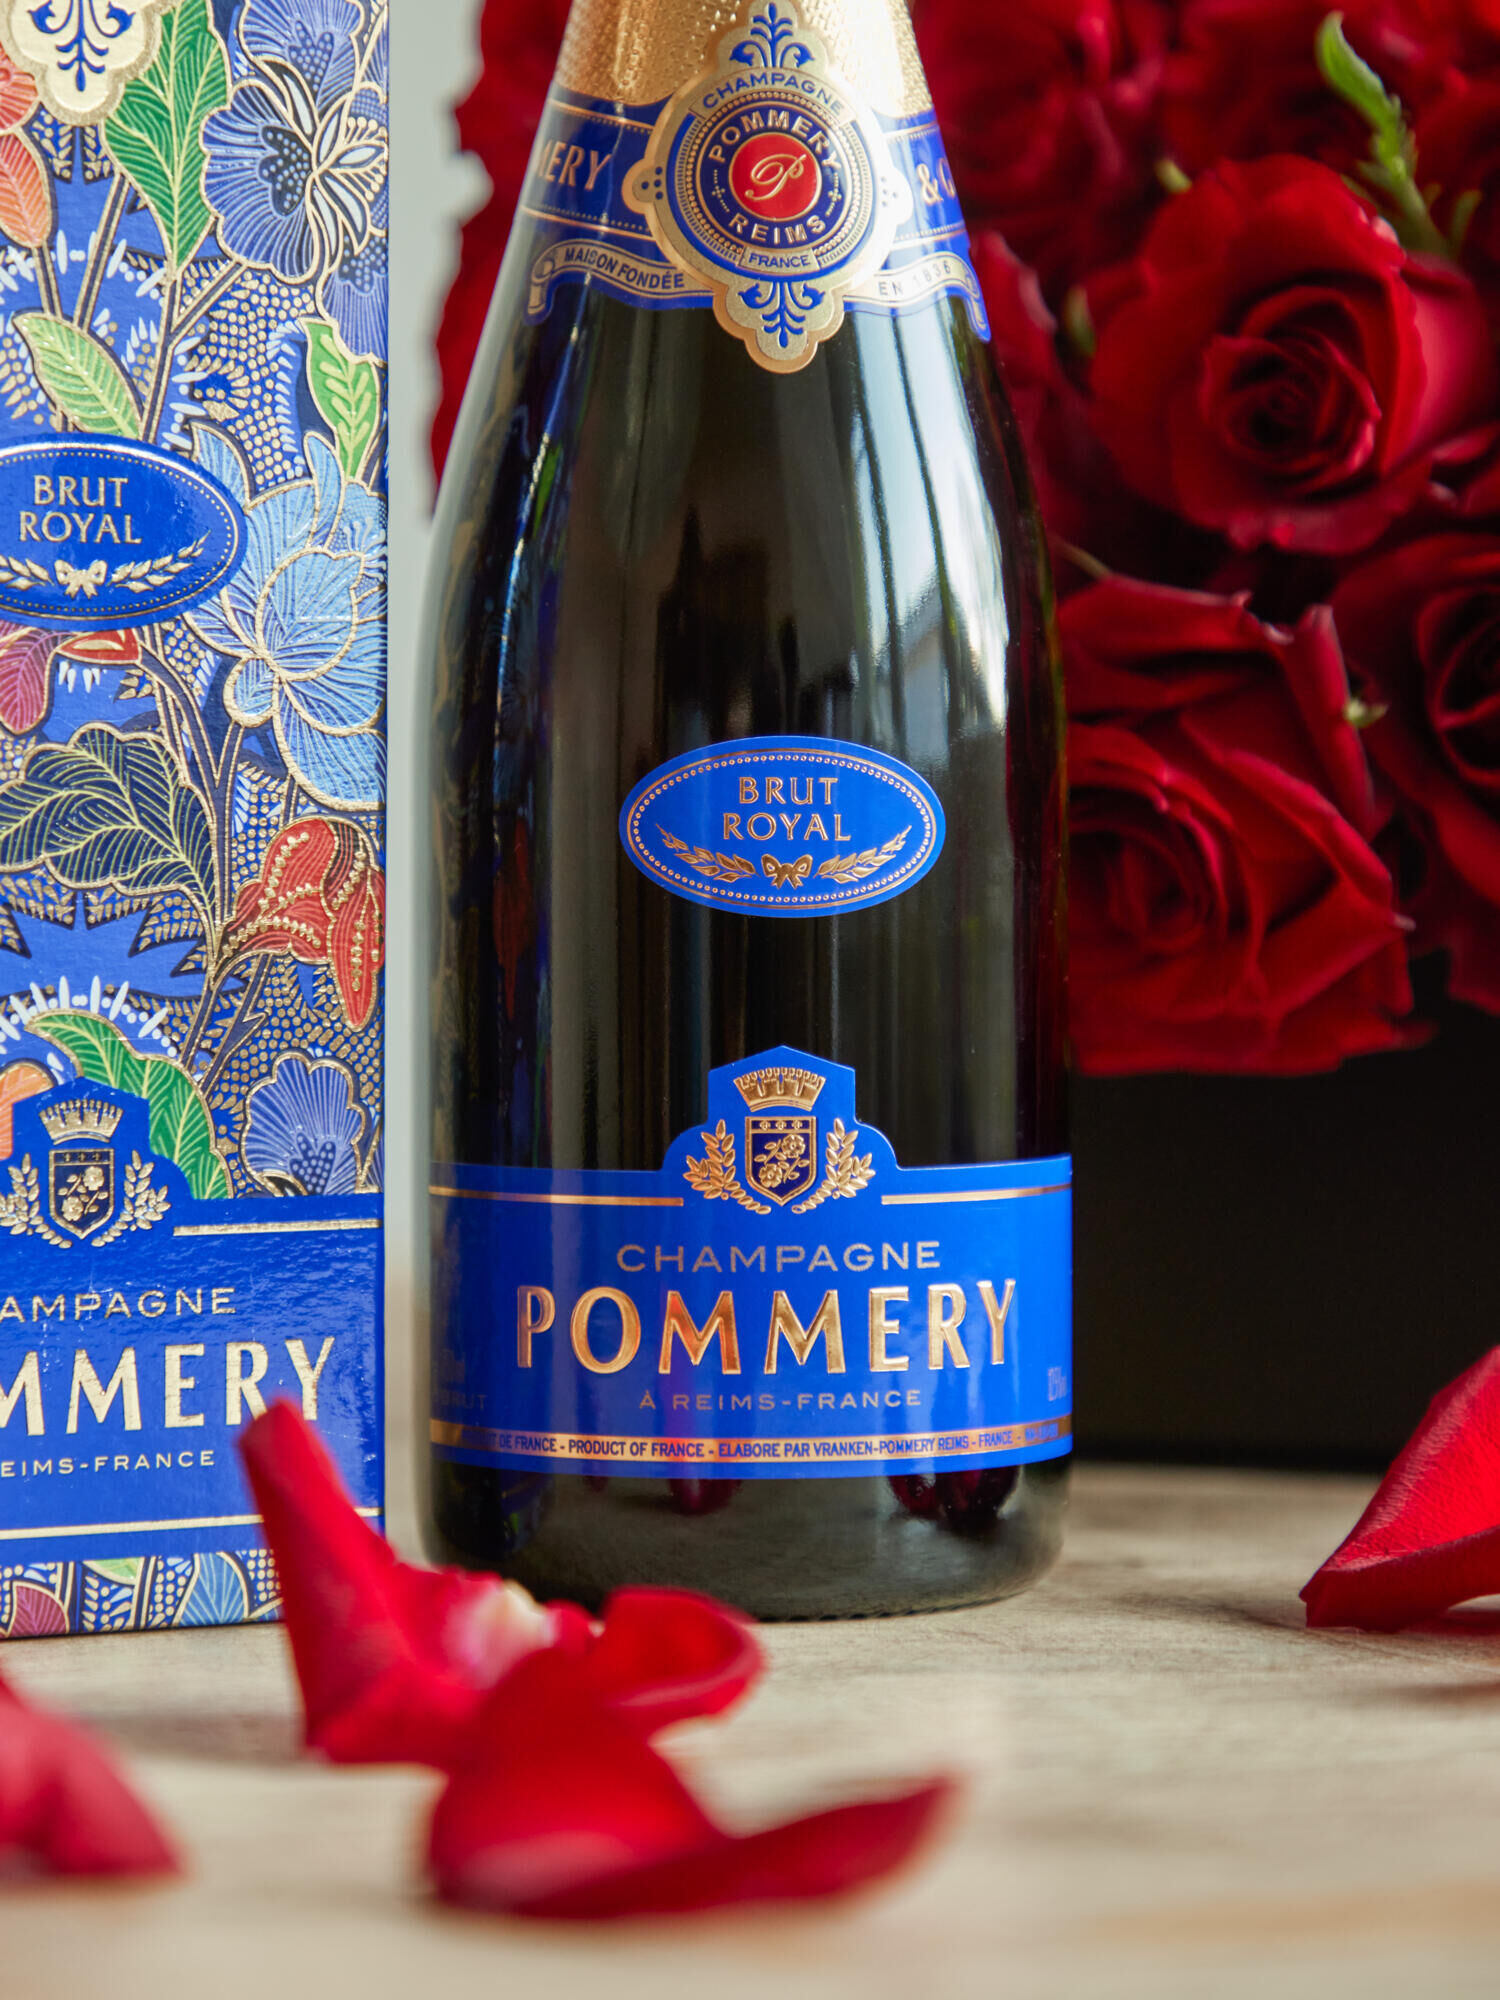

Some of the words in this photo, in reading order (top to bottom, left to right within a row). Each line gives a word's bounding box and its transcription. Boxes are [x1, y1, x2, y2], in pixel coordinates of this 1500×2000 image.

[702, 72, 845, 116] CHAMPAGNE
[708, 109, 842, 170] POMMERY
[537, 139, 614, 191] ERY
[728, 212, 826, 245] REIMS
[564, 248, 617, 274] MAISON
[617, 265, 686, 291] FONDÉE
[878, 281, 903, 296] EN
[748, 253, 811, 270] FRANCE
[33, 475, 129, 508] BRUT
[18, 510, 142, 544] ROYAL
[738, 776, 839, 805] BRUT
[722, 812, 852, 842] ROYAL
[616, 1240, 942, 1273] CHAMPAGNE
[516, 1278, 1017, 1374] POMMERY
[639, 1390, 656, 1410] À
[672, 1389, 922, 1411] REIMS-FRANCE
[514, 1435, 558, 1453] FRANCE
[567, 1439, 627, 1457] PRODUCT
[629, 1442, 649, 1457] OF
[651, 1443, 705, 1458] FRANCE
[718, 1442, 781, 1458] ELABORE
[783, 1442, 811, 1457] PAR
[812, 1437, 936, 1458] VRANKEN-POMMERY
[937, 1434, 970, 1451] REIMS
[978, 1430, 1014, 1448] FRANCE
